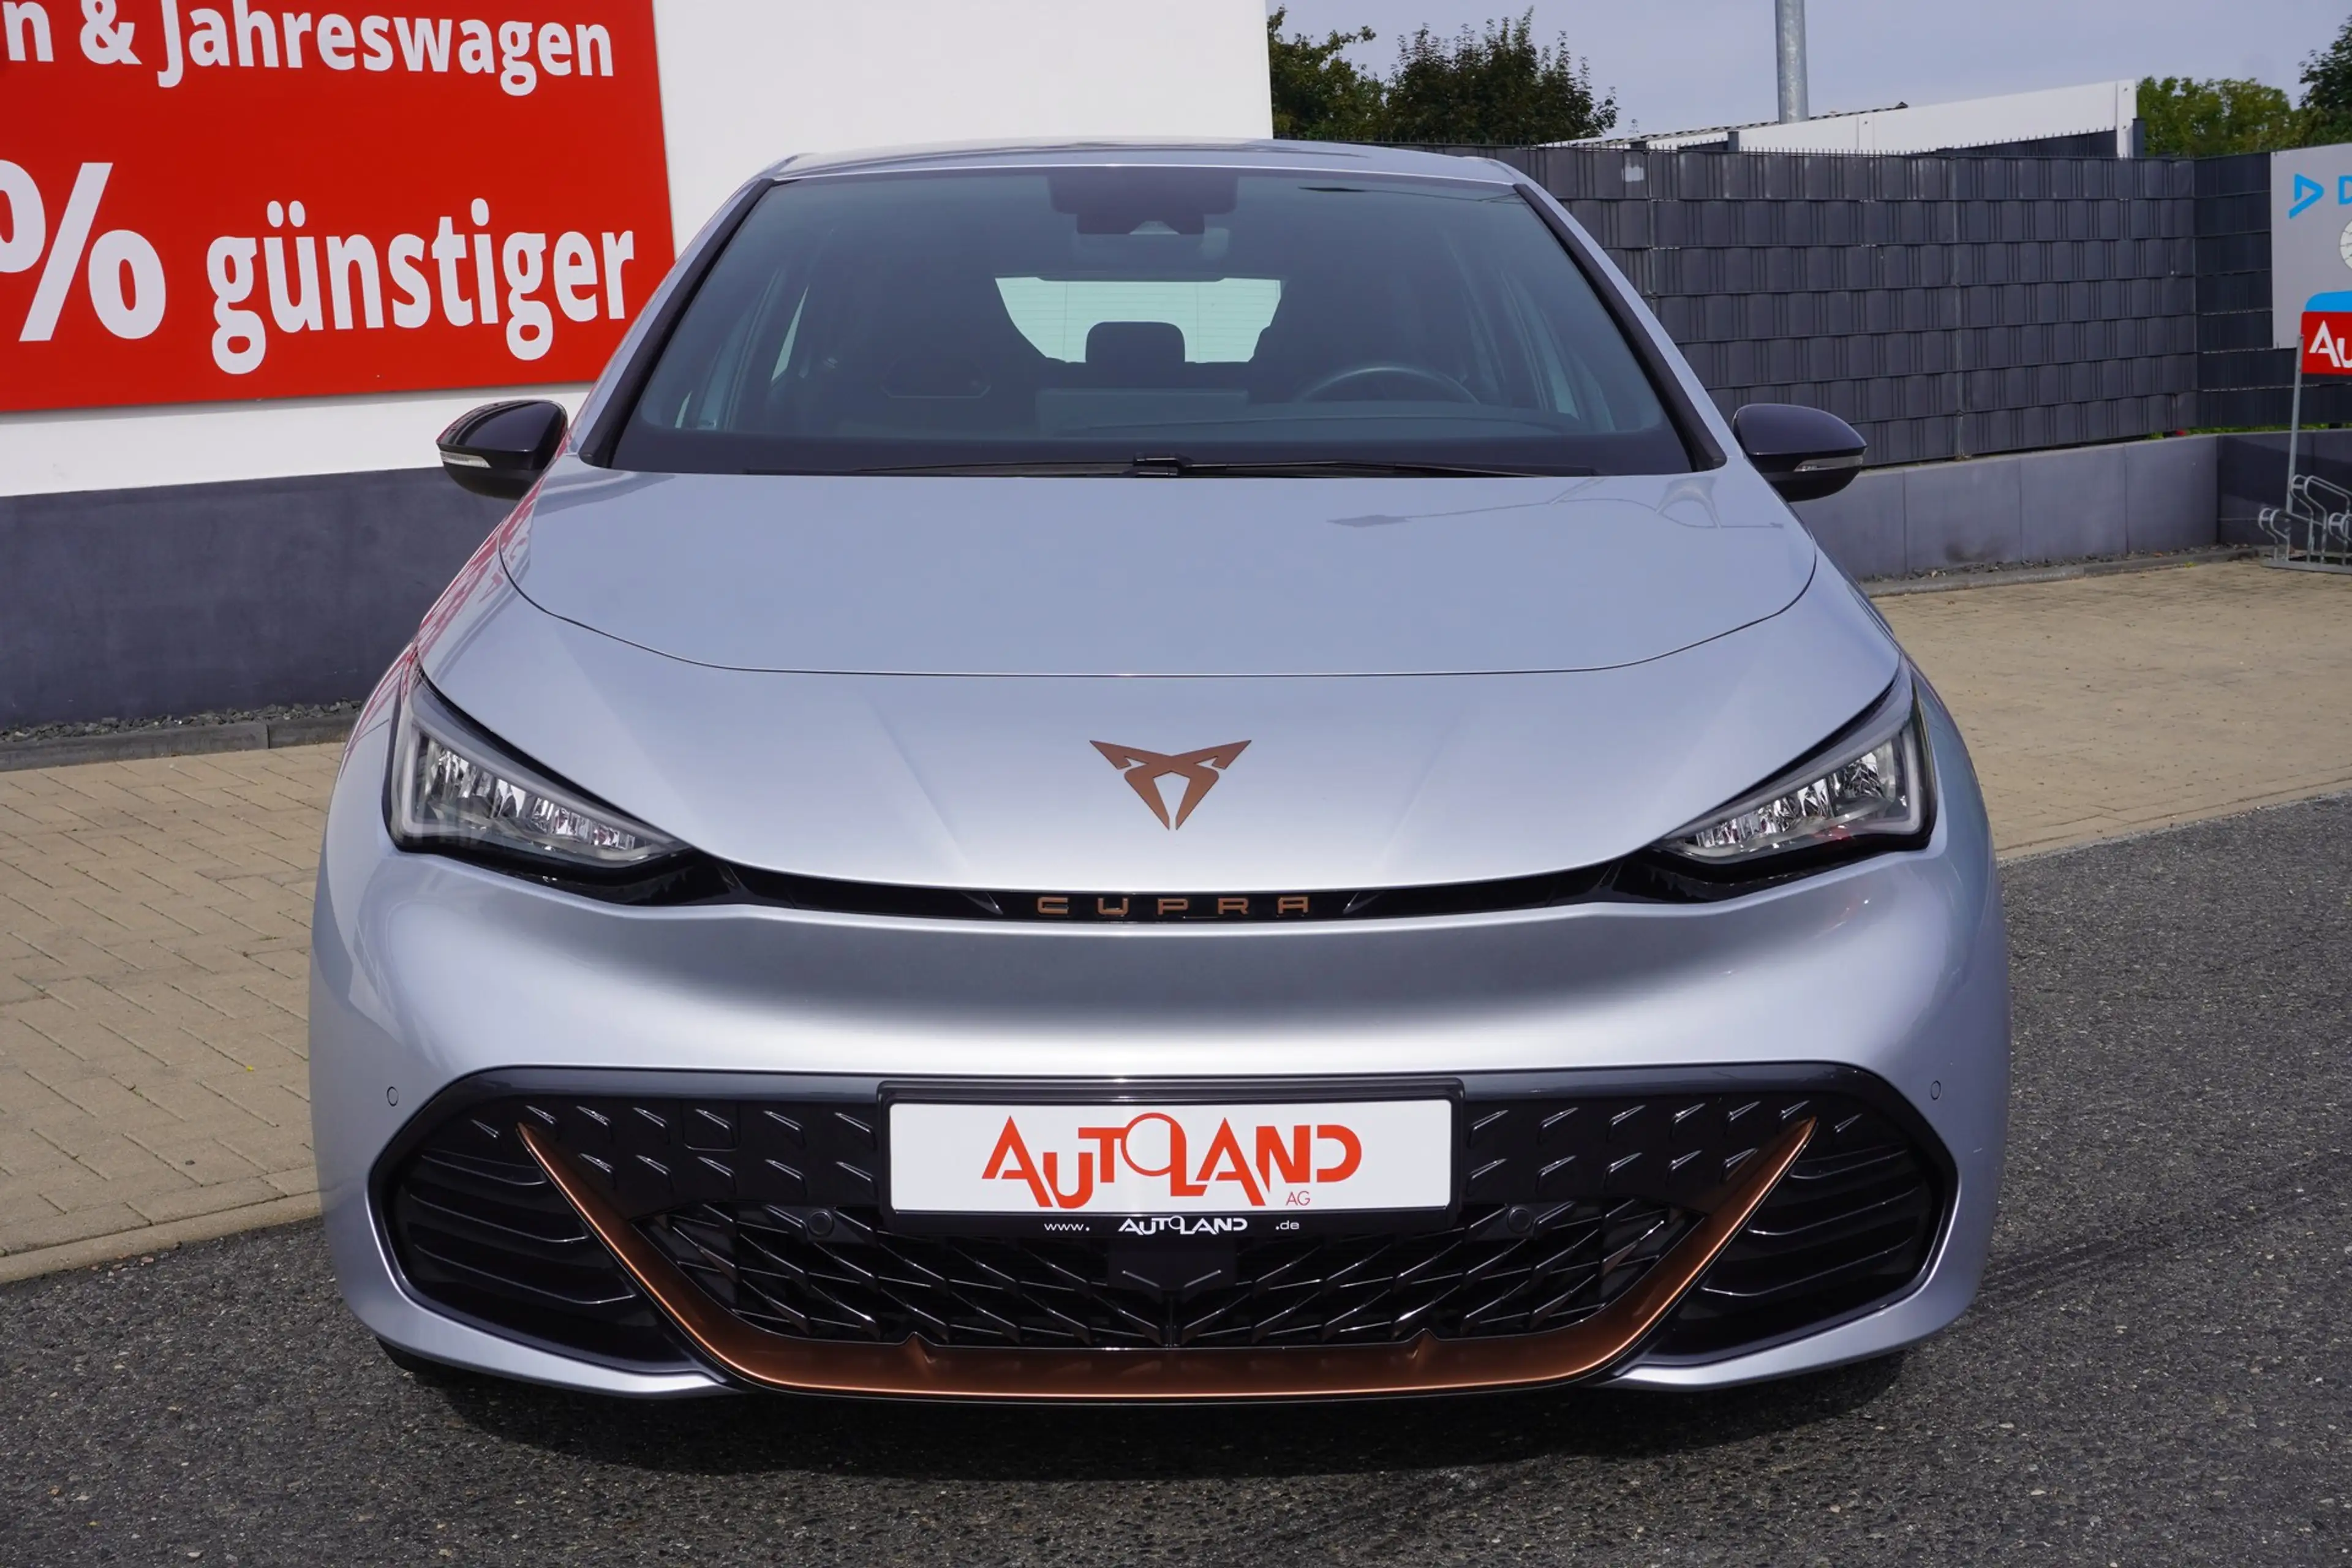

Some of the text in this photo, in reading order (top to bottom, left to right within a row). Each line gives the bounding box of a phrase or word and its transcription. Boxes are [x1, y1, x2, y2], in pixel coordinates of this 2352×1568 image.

[80, 0, 143, 65] &
[157, 0, 614, 96] Jahreswagen
[206, 198, 634, 375] günstiger
[1037, 896, 1309, 915] CUPRA
[981, 1112, 1362, 1209] AUTOLAND
[1044, 1223, 1090, 1232] www.
[1275, 1221, 1300, 1230] .de
[1285, 1191, 1311, 1207] AG
